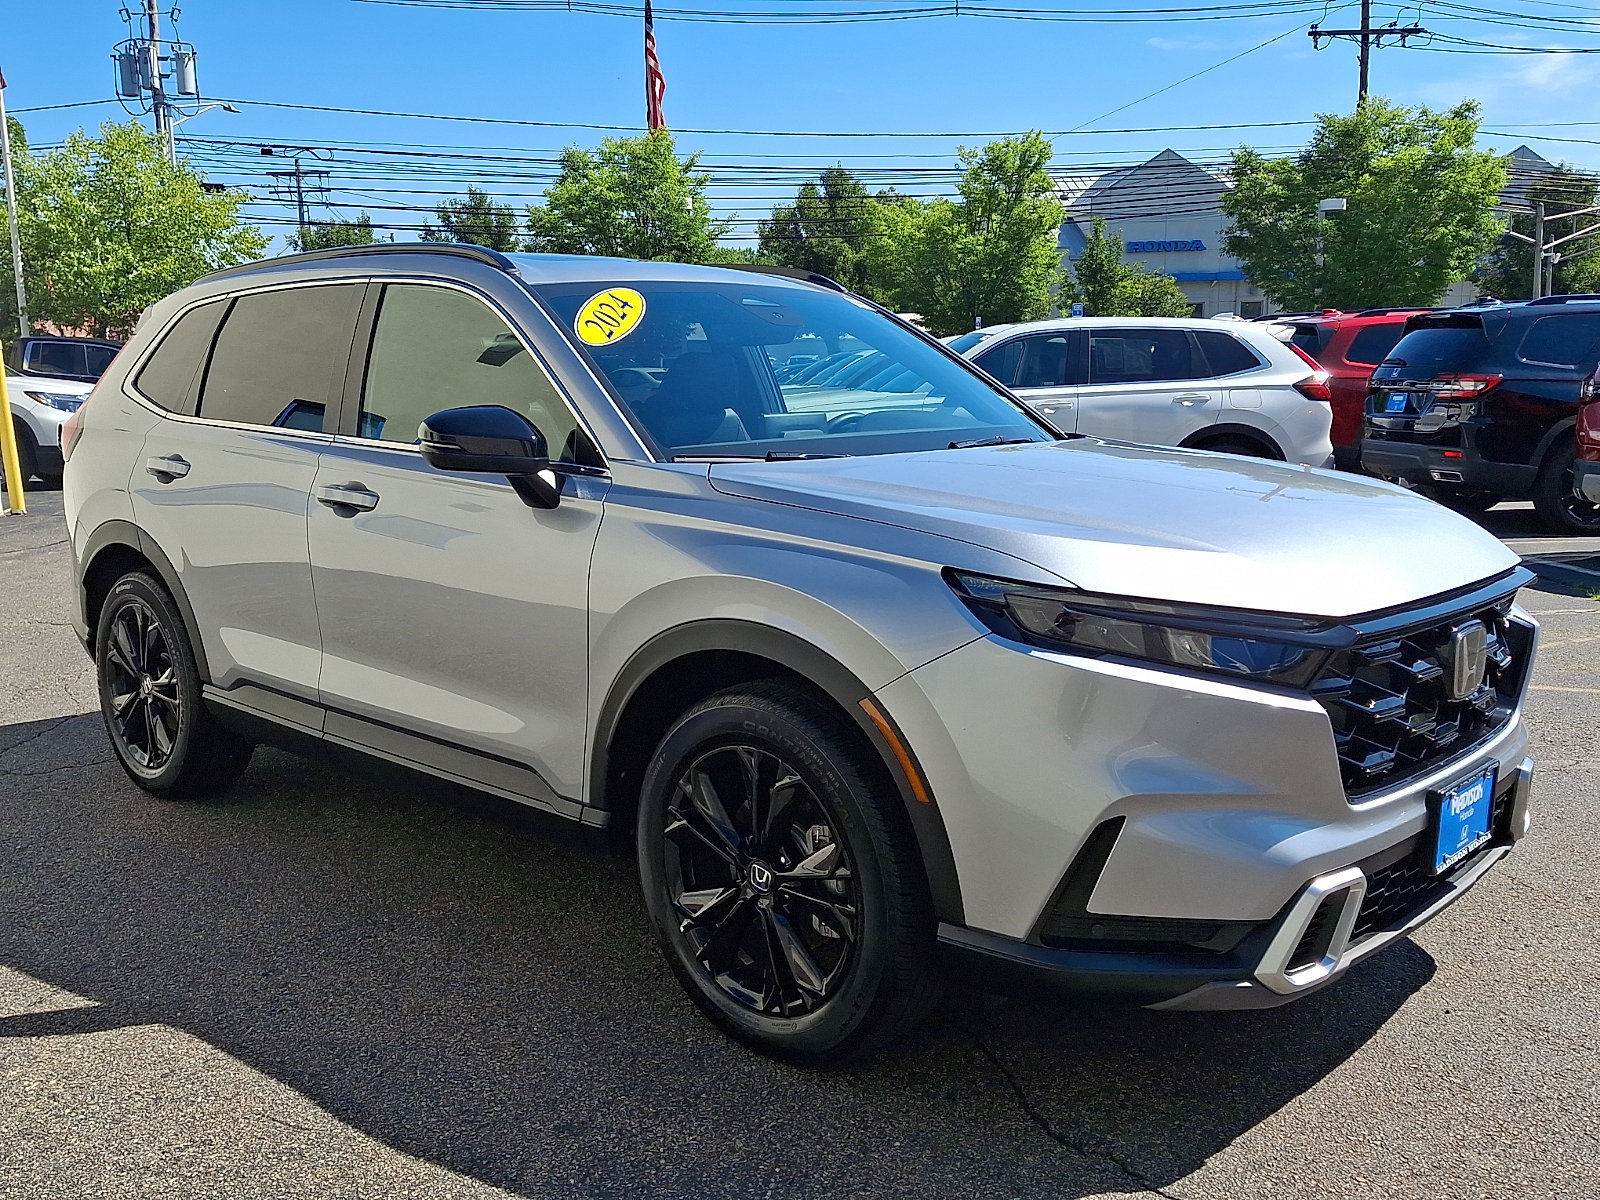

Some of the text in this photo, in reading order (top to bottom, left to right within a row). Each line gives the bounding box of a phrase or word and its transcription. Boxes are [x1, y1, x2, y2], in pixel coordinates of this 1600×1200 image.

[1126, 240, 1207, 253] HONDA
[585, 292, 634, 339] 2024
[1451, 783, 1484, 816] MADISON
[1460, 807, 1475, 823] Honda
[1436, 846, 1468, 875] MADISON
[1468, 832, 1493, 854] HONDA
